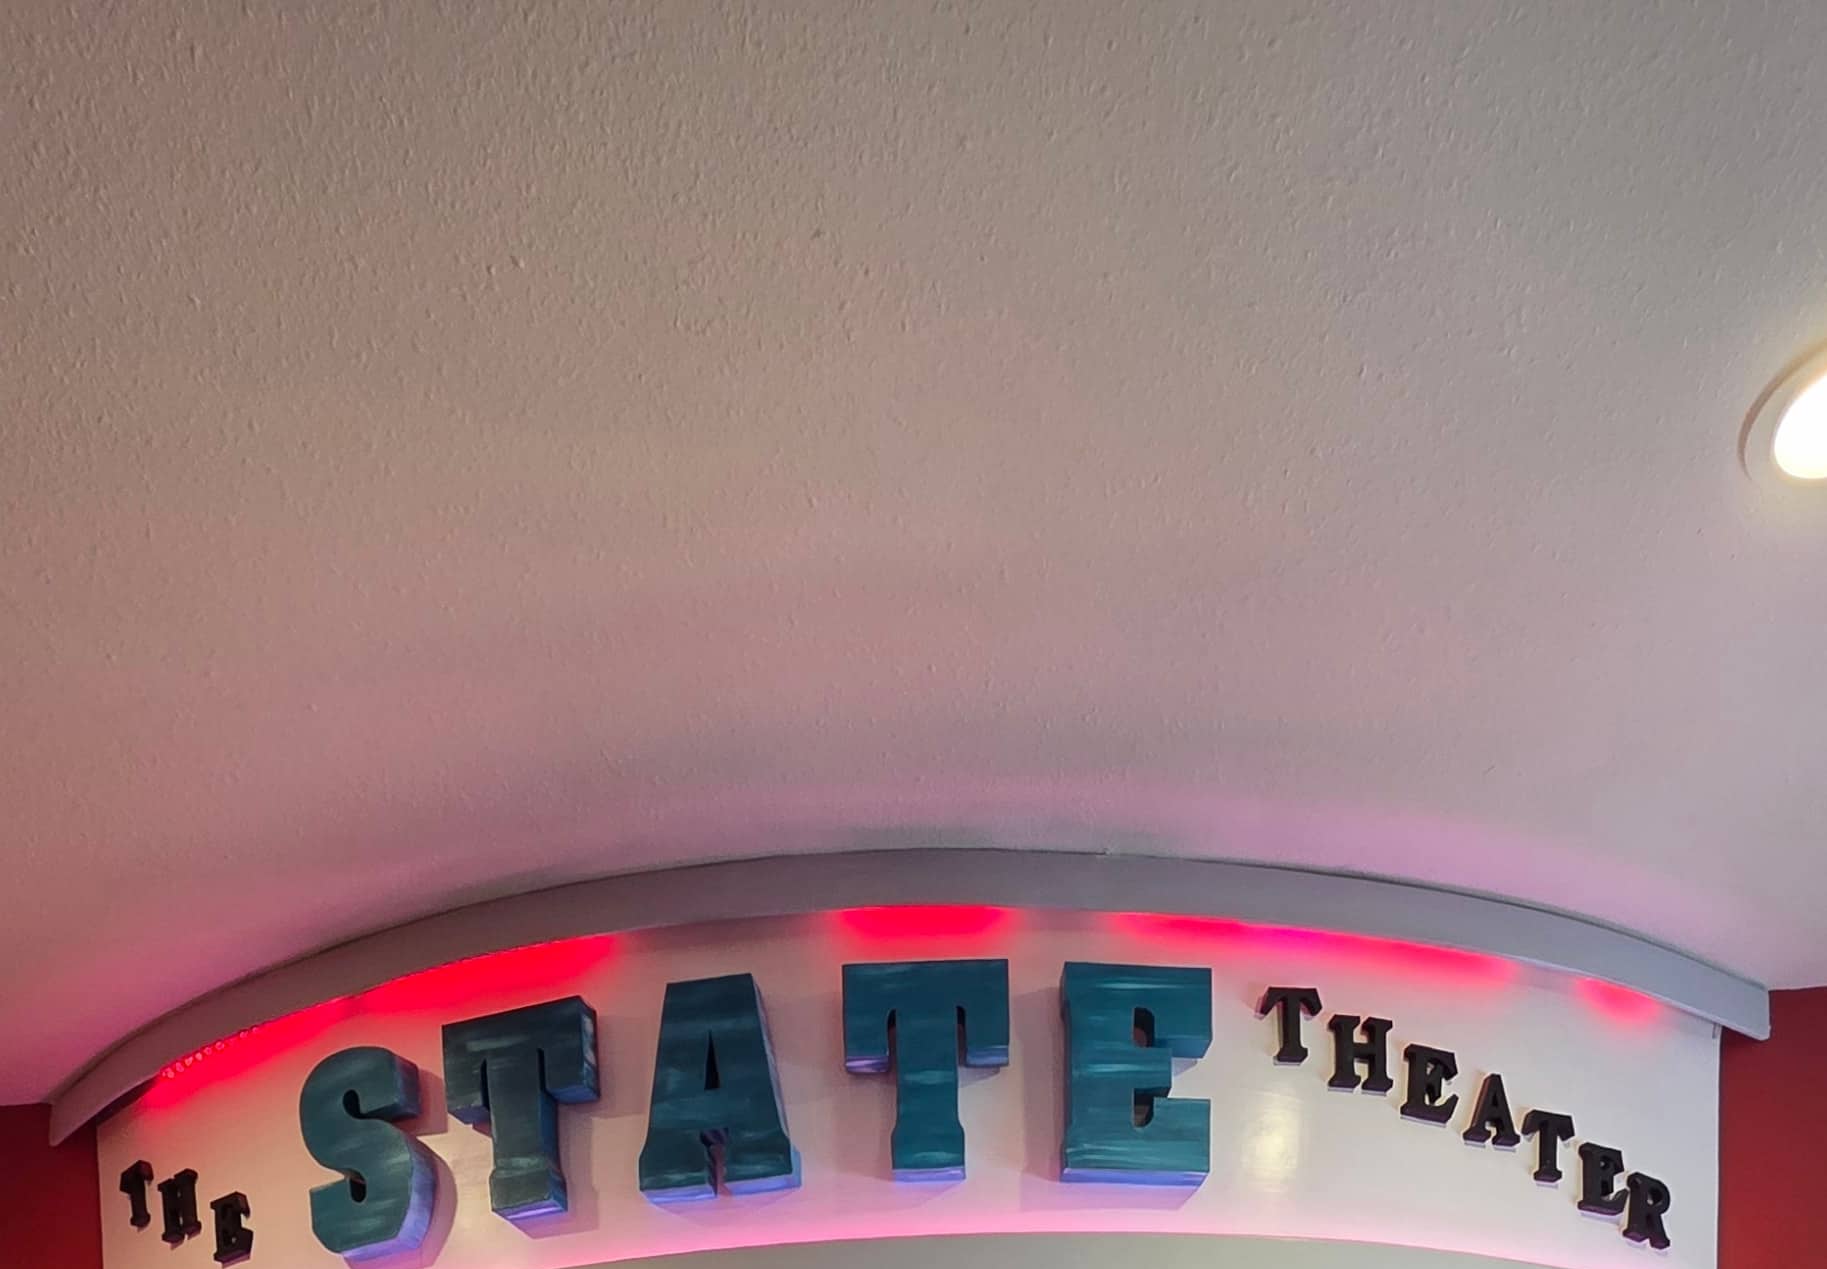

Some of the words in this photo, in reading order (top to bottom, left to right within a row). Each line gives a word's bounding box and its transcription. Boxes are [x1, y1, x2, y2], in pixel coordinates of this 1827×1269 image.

[120, 1160, 253, 1265] THE
[299, 959, 1213, 1262] STATE
[1261, 986, 1672, 1250] THEATER
